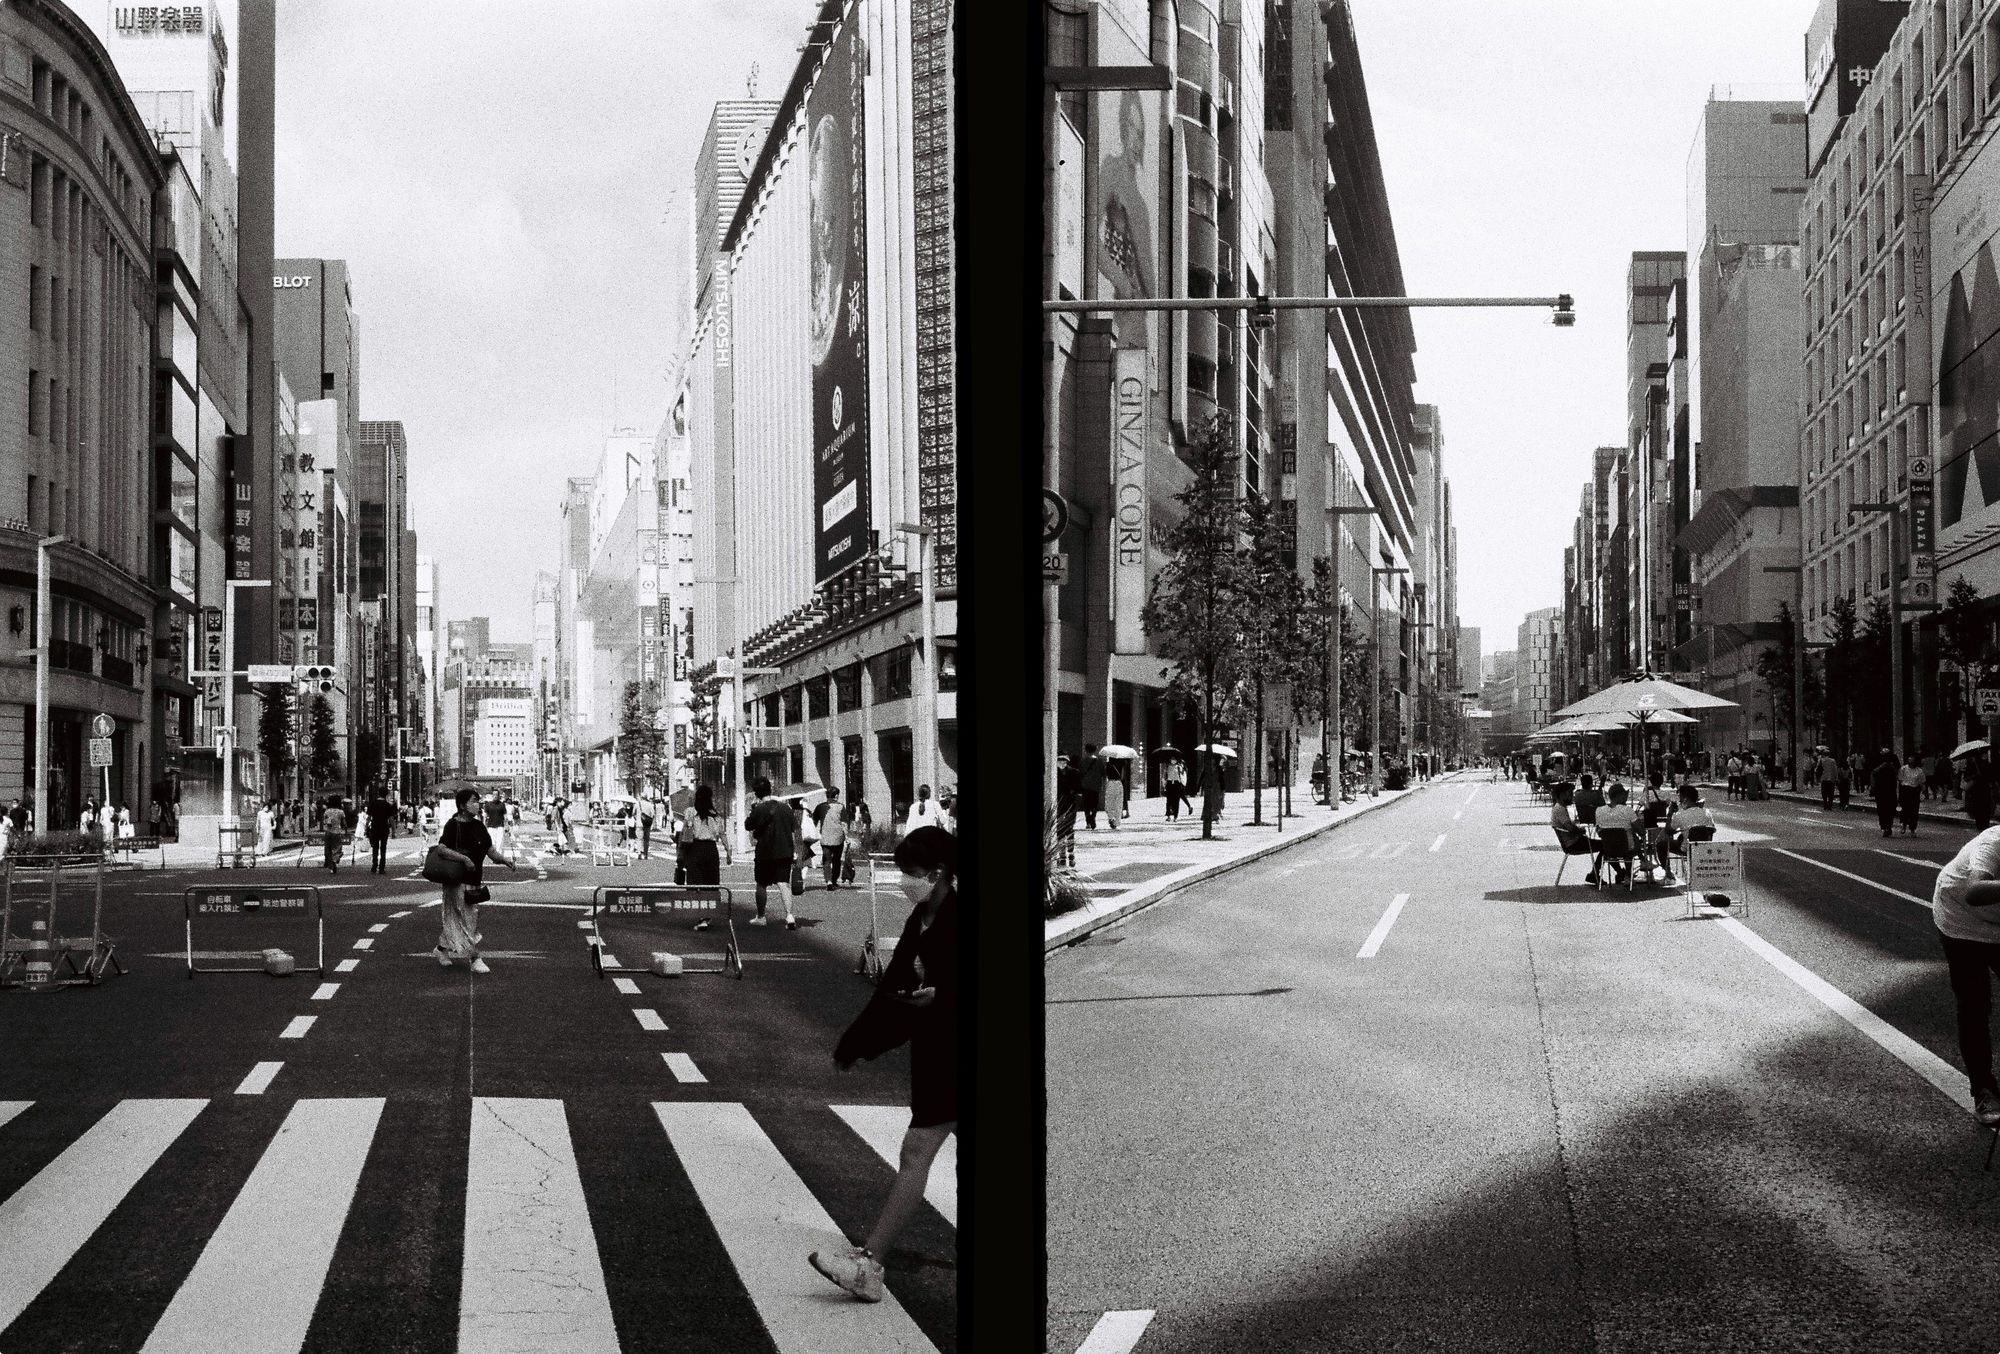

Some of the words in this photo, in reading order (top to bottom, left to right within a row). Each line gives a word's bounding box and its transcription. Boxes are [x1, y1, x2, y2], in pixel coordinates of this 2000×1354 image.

[115, 6, 203, 30] 山野楽器
[715, 259, 729, 368] MITSUKOSHI
[1119, 377, 1143, 473] GINZA
[235, 484, 251, 578] 山野楽器
[299, 452, 315, 549] 教文館
[1119, 483, 1143, 566] CORE
[299, 603, 315, 624] 本
[199, 904, 240, 913] 乗入れ禁止
[207, 895, 232, 904] 自転車
